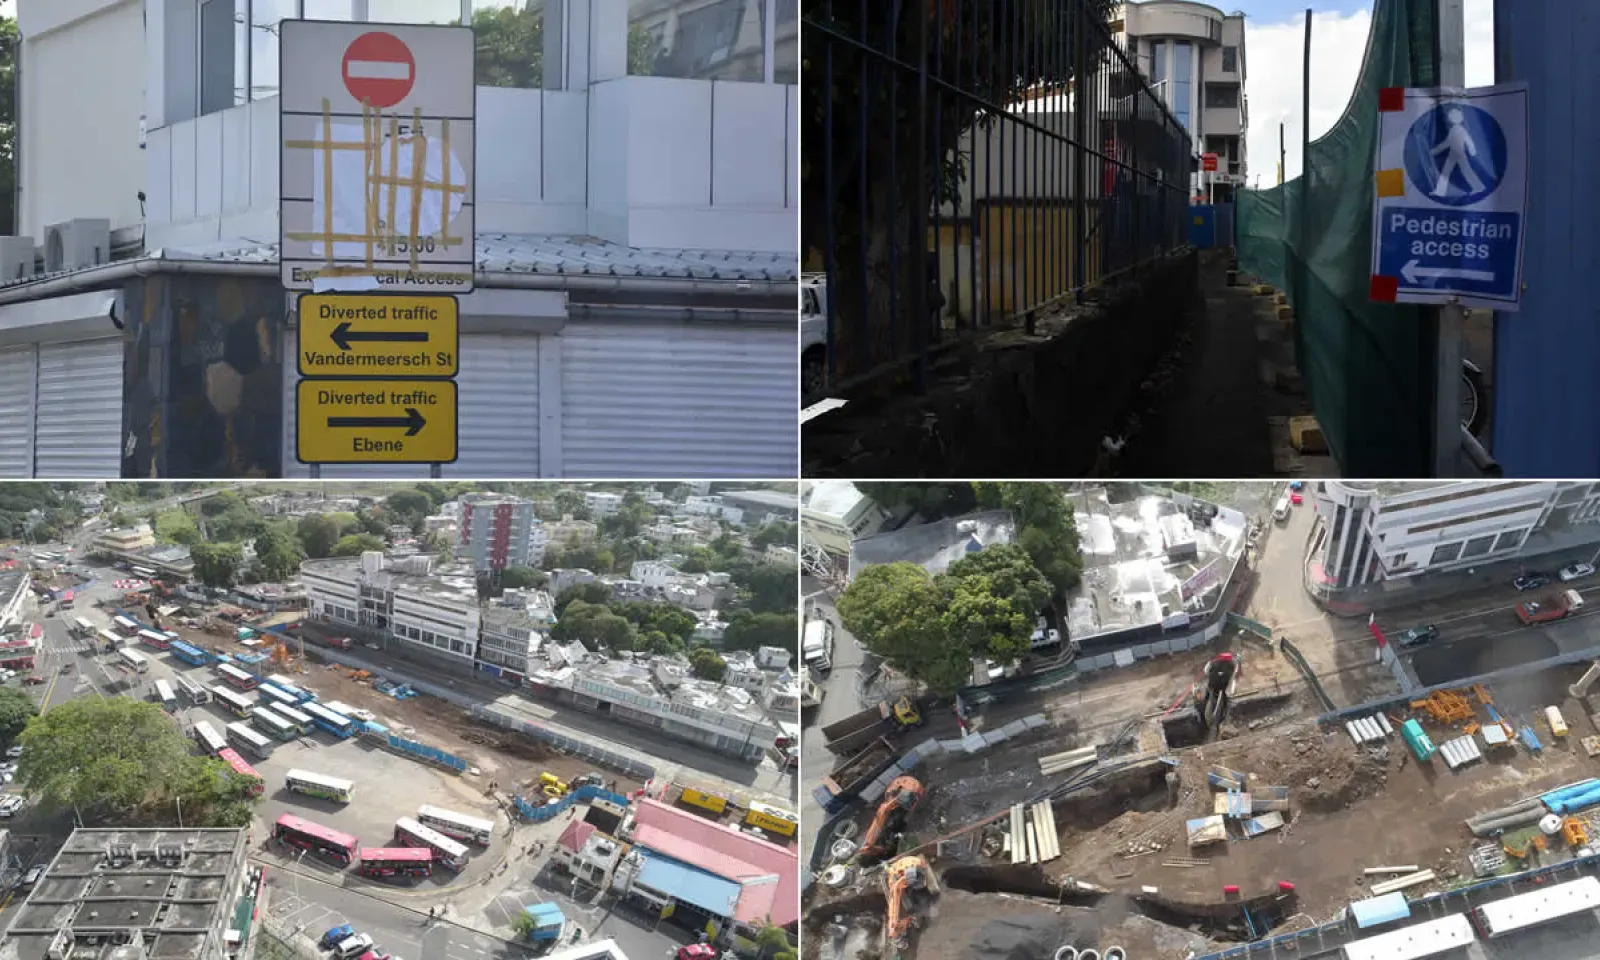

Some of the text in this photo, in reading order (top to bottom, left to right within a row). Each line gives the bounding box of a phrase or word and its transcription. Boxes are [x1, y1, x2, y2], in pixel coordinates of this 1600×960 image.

[1391, 214, 1511, 239] Pedestrian
[1411, 240, 1489, 259] access
[404, 271, 464, 286] Access
[319, 304, 438, 320] Diverted traffic
[304, 351, 453, 367] Vandermeersch St
[318, 390, 438, 405] Diverted traffic
[352, 437, 404, 452] Ebene
